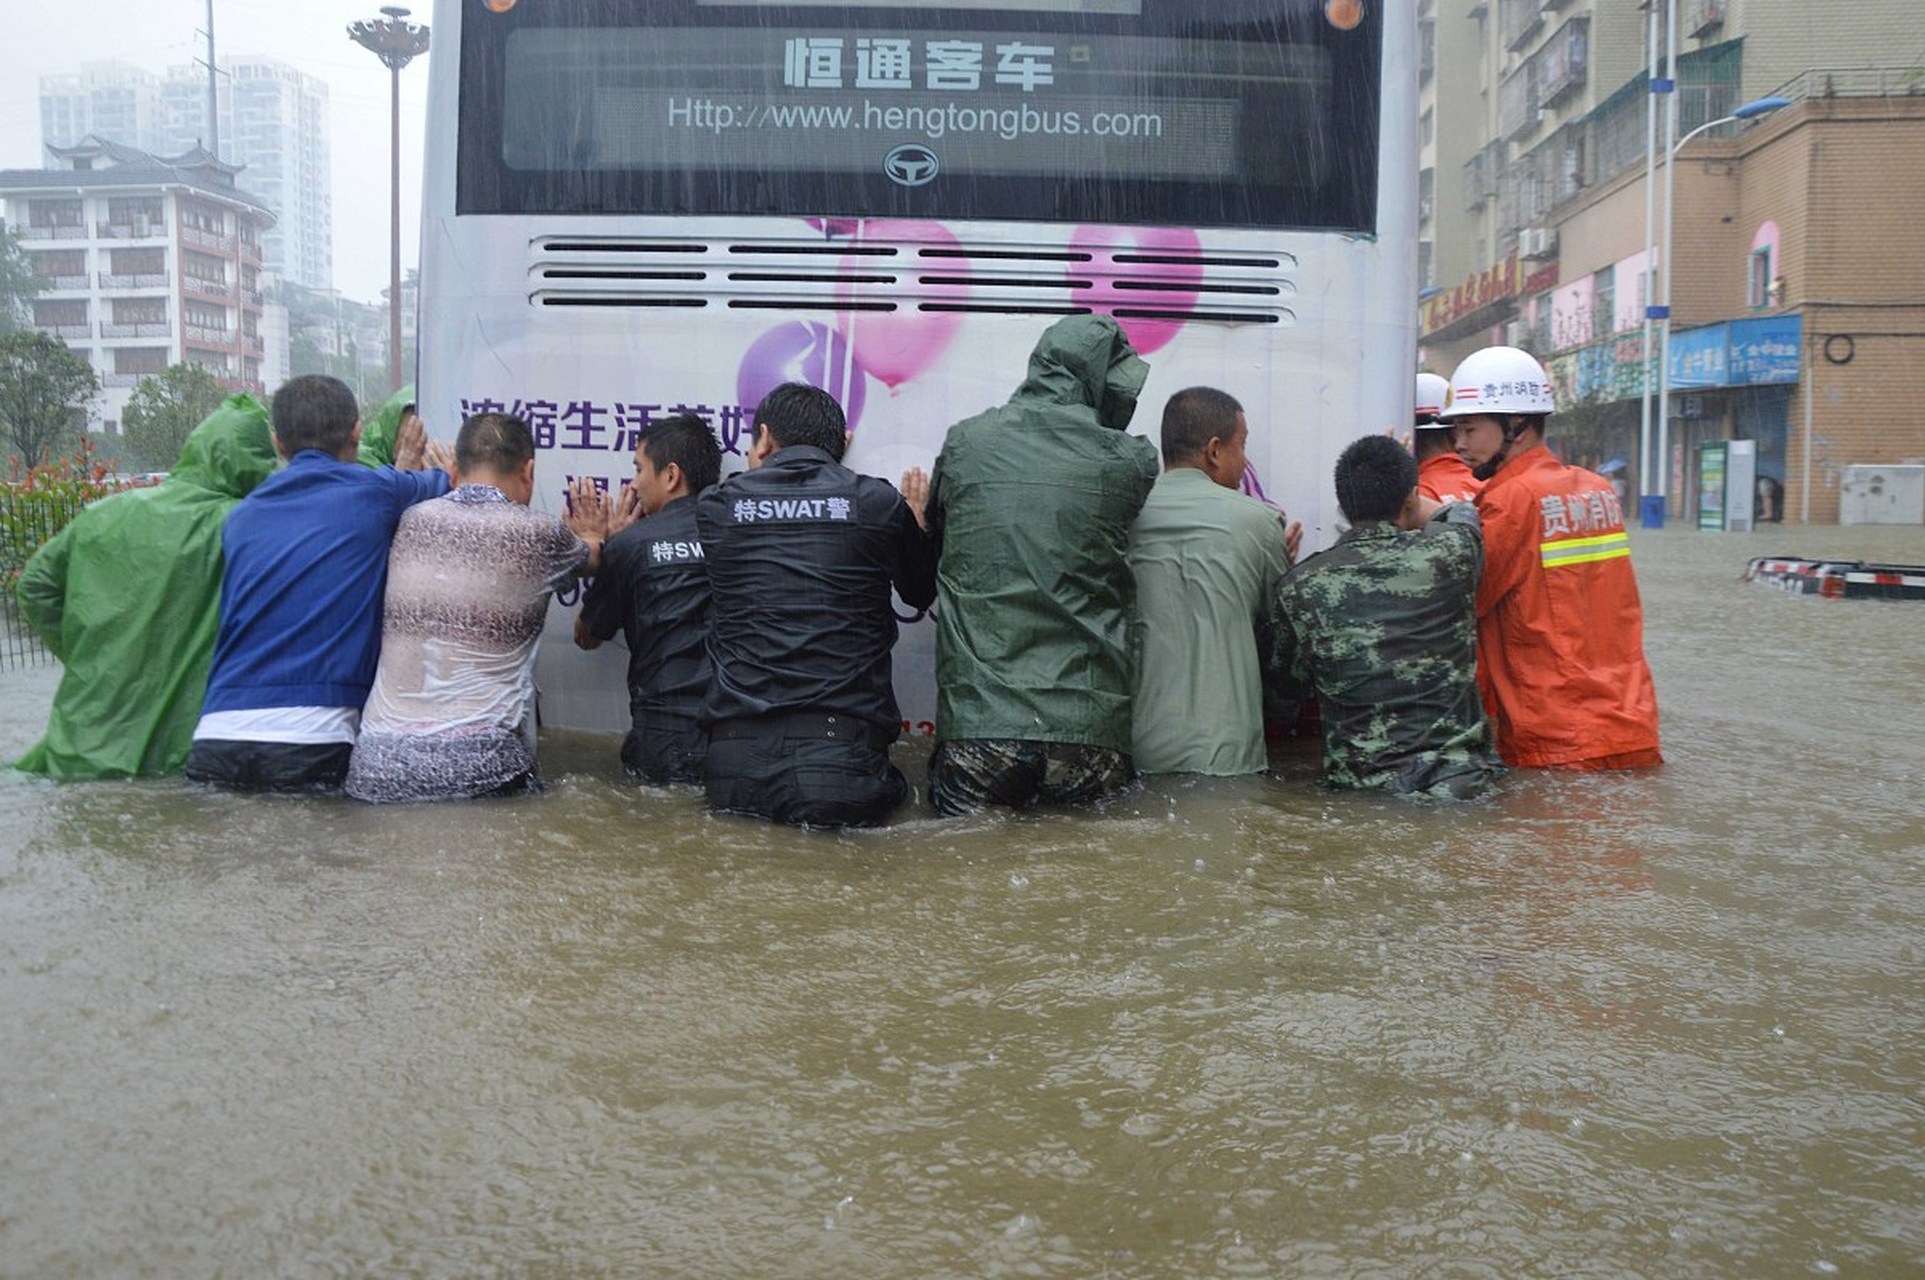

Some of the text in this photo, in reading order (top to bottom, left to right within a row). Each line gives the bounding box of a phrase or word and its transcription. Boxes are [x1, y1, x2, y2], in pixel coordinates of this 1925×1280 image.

[784, 37, 1055, 92] 恒通客车
[668, 97, 1162, 140] Http://www.hengtongbus.com
[1483, 381, 1540, 399] 贵州消防
[460, 398, 757, 457] 缩生活好
[734, 497, 850, 522] 特SWAT警
[1540, 489, 1622, 538] 贵州消防
